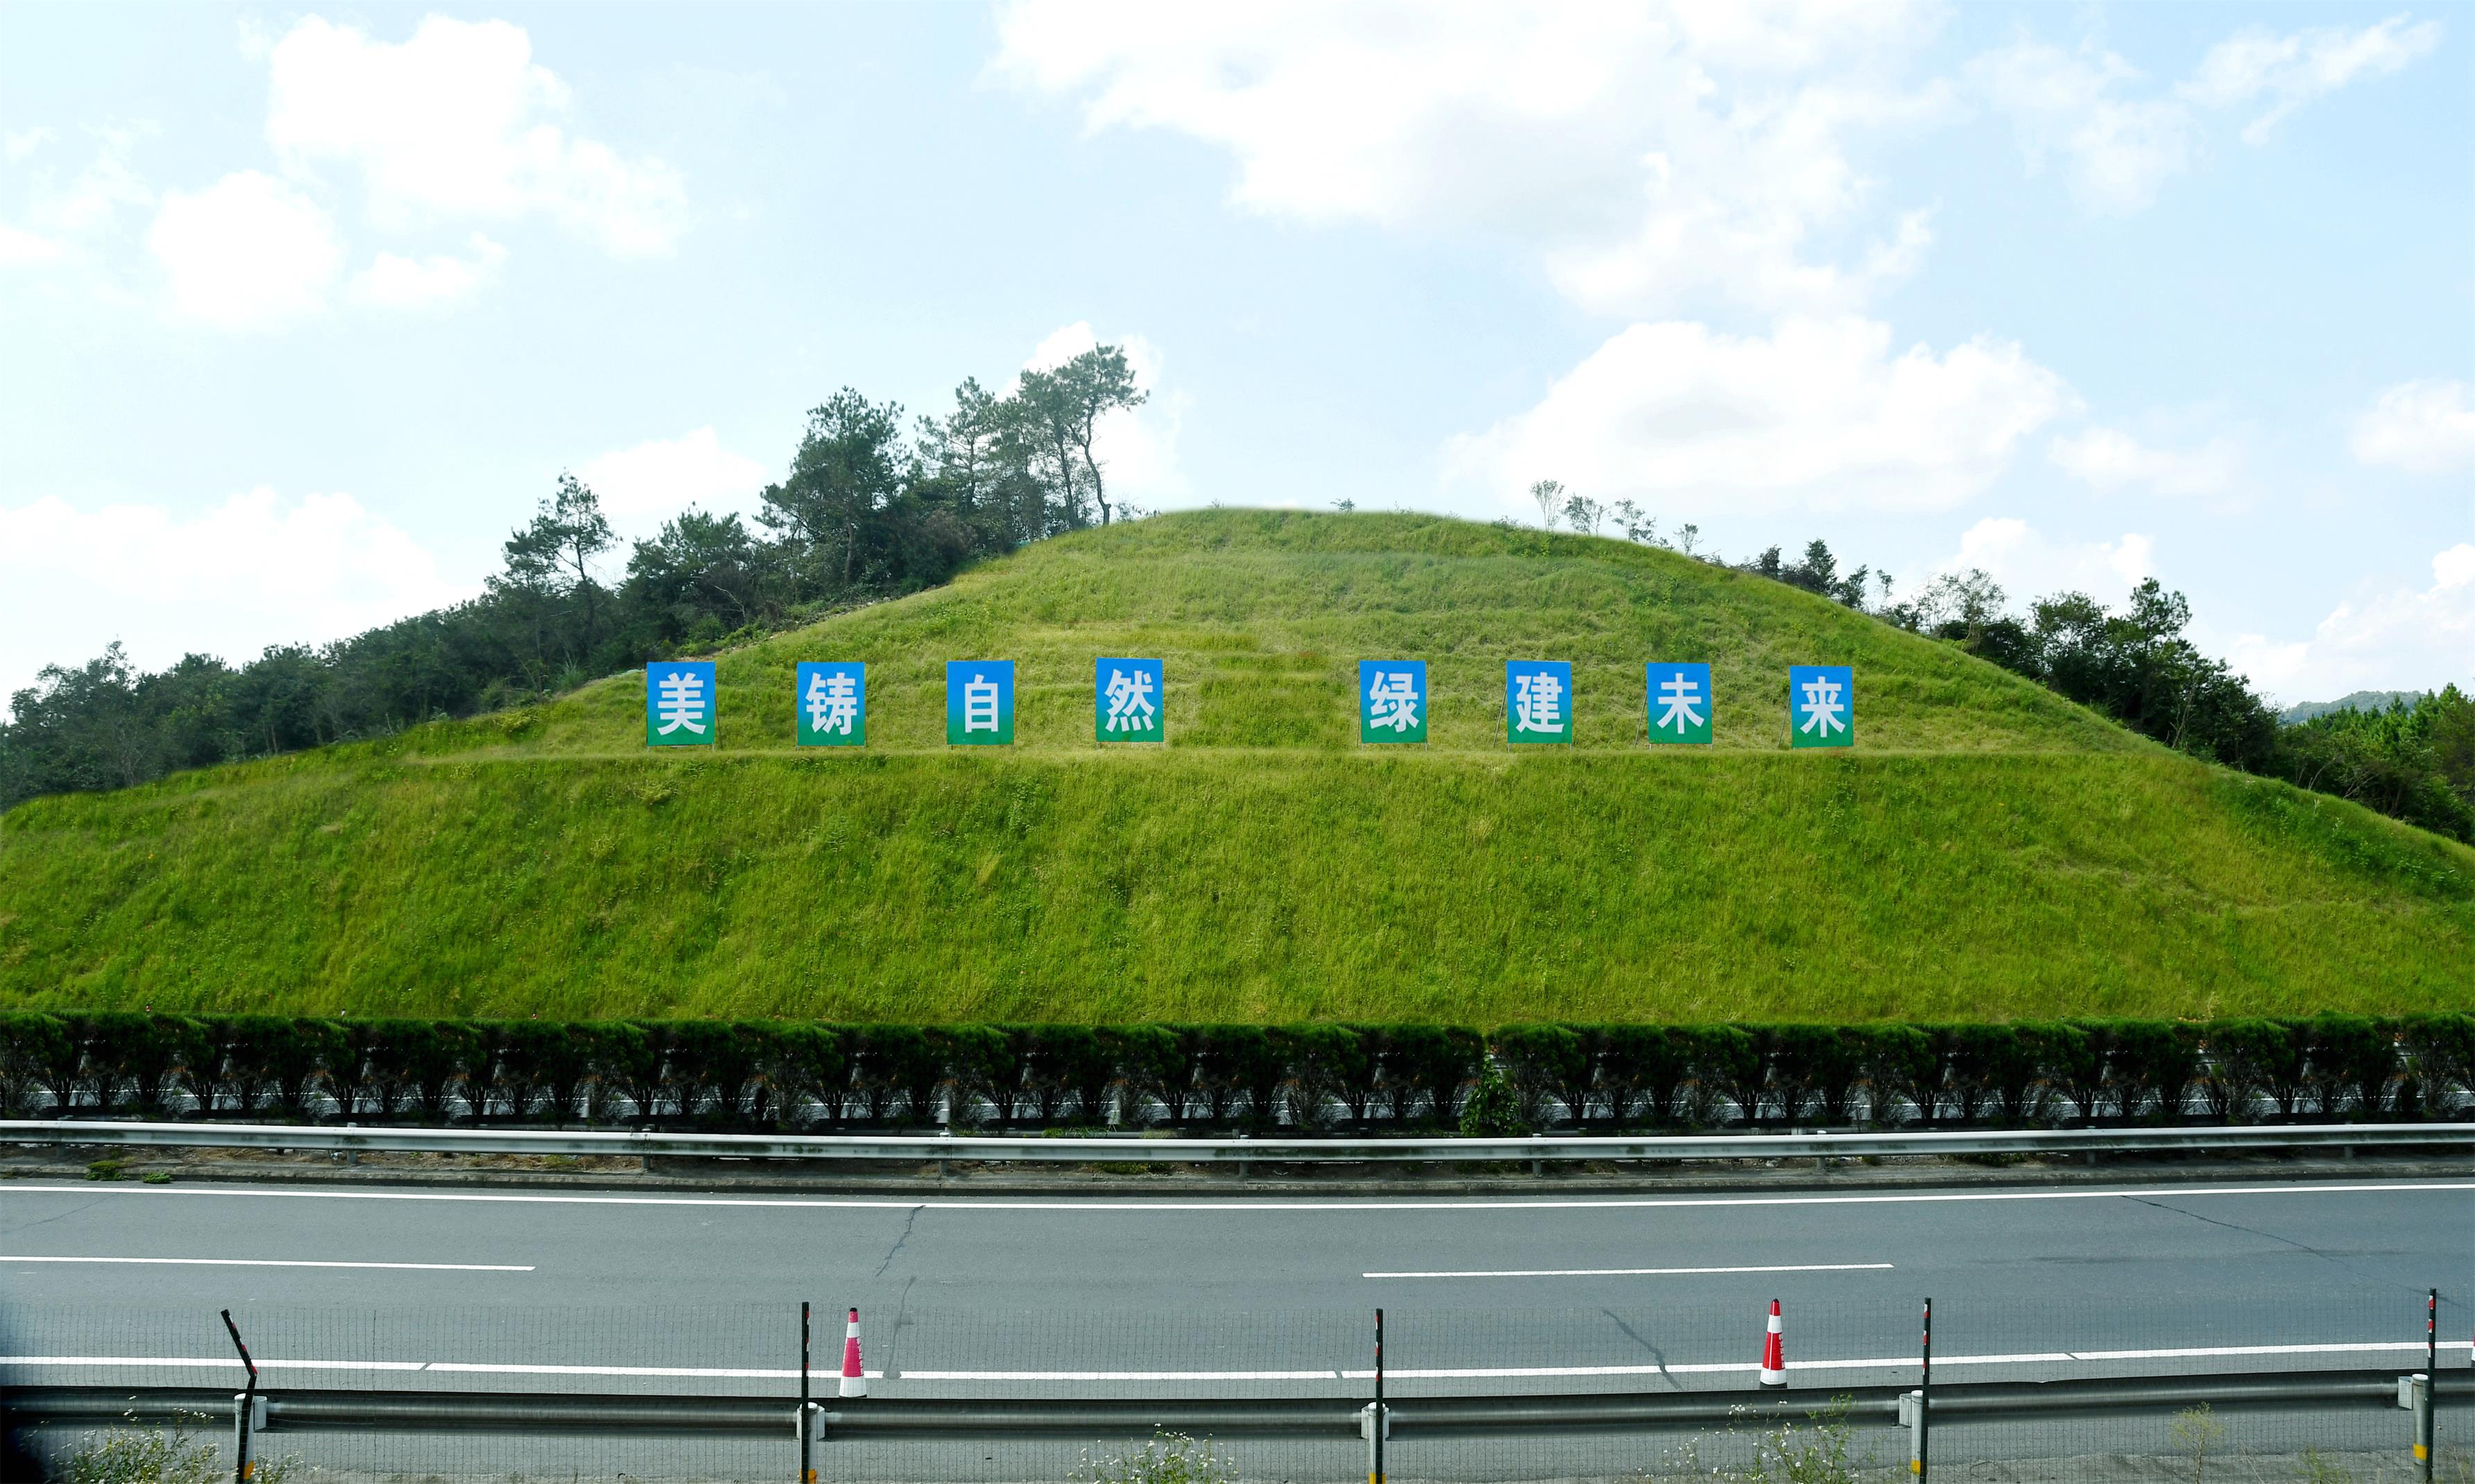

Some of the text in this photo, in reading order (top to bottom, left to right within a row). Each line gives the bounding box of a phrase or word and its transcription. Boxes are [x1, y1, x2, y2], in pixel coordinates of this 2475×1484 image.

[657, 669, 1846, 738] 美铸自然 绿建未来
